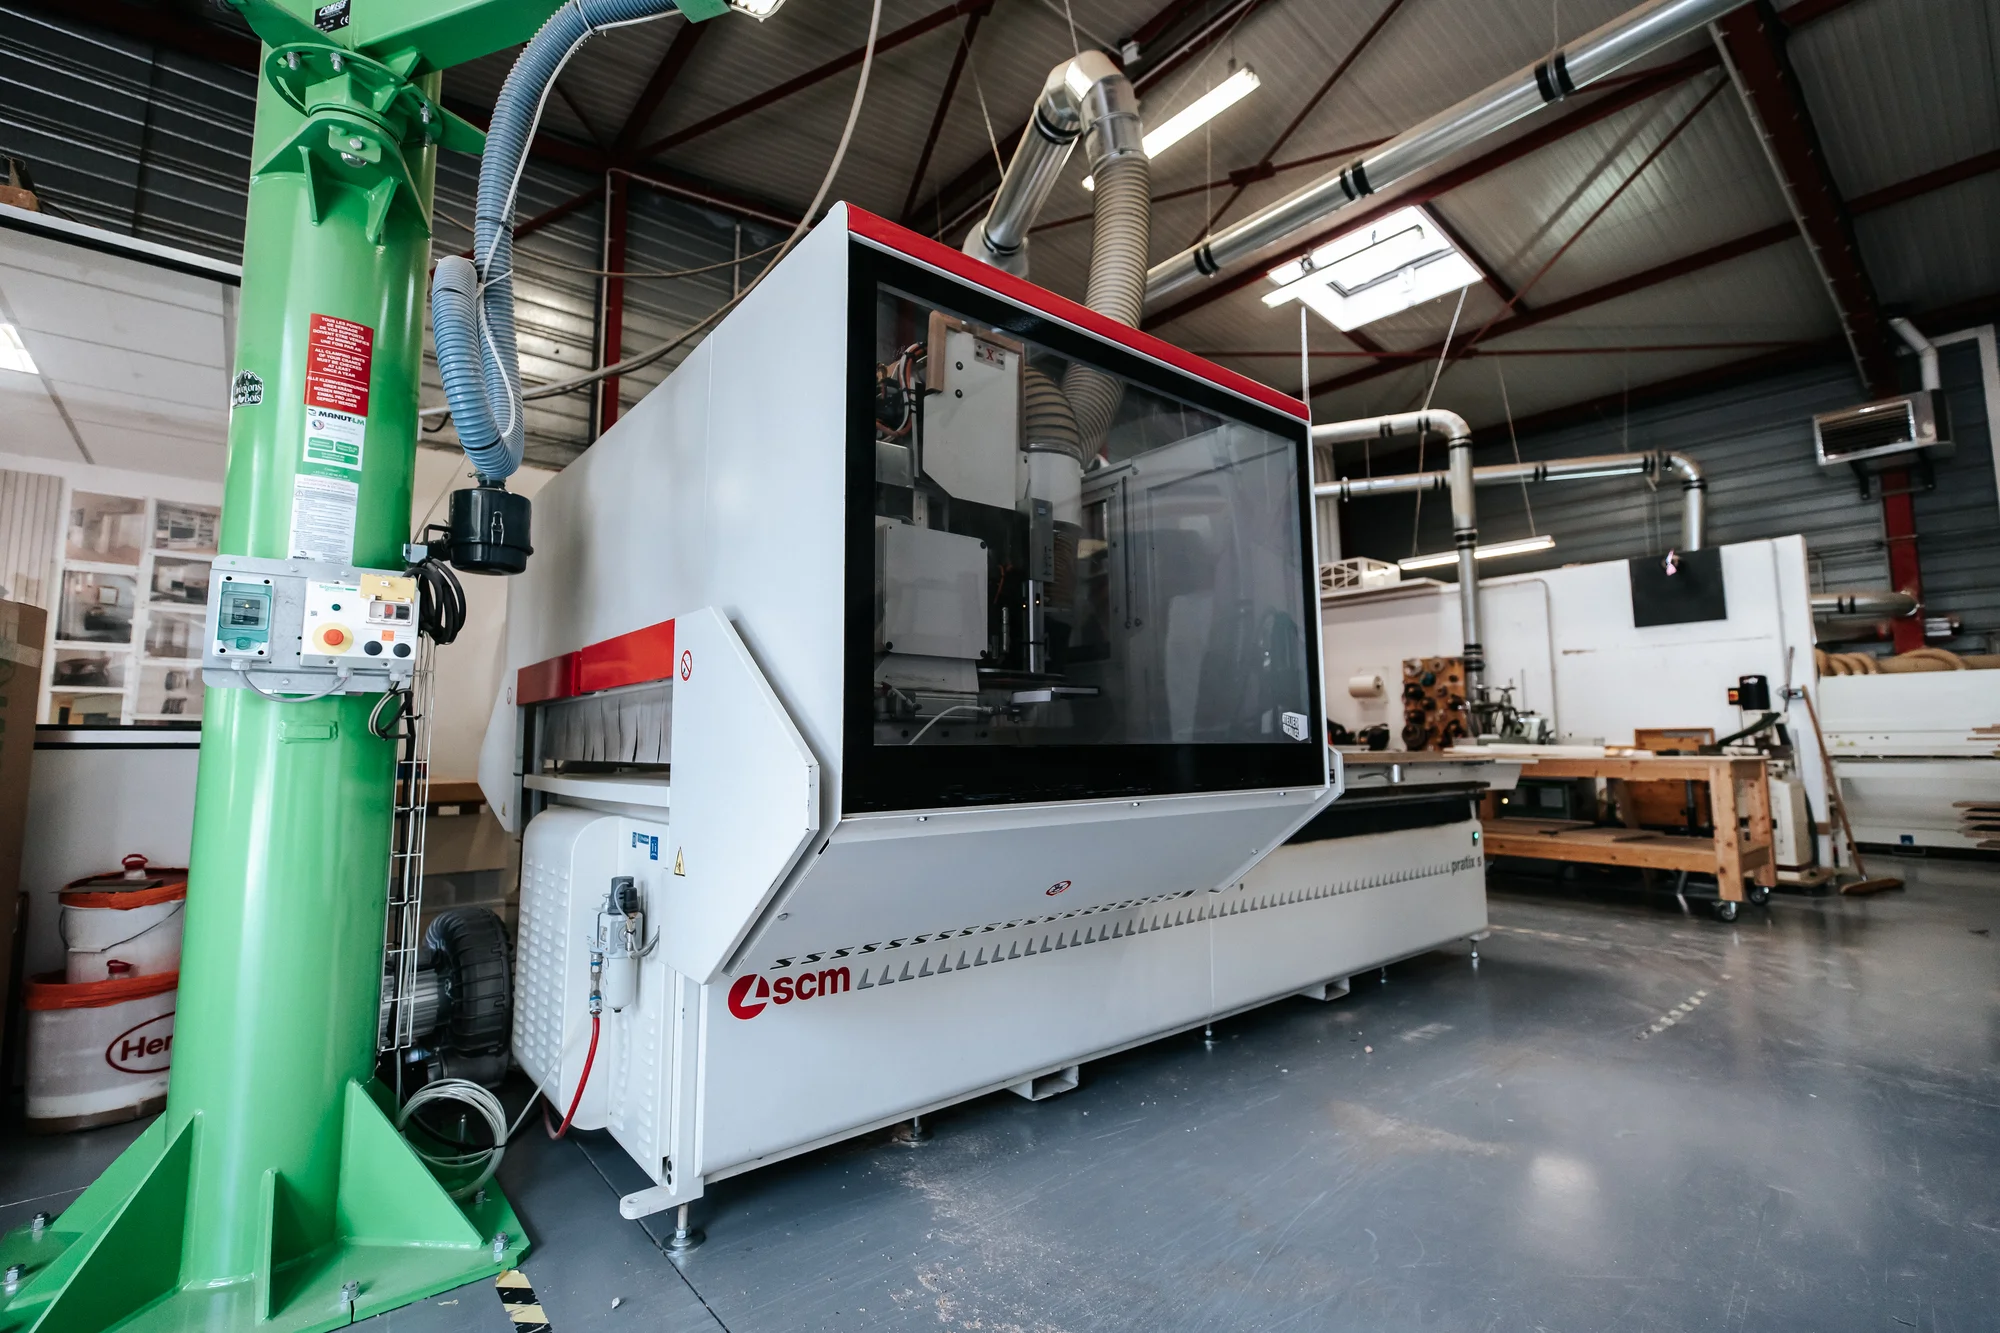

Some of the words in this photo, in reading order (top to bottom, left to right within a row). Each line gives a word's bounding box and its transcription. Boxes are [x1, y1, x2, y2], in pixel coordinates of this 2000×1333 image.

[986, 348, 994, 361] X
[319, 411, 364, 426] MANUT-LM
[1452, 855, 1475, 876] pratix
[773, 966, 850, 1005] scm
